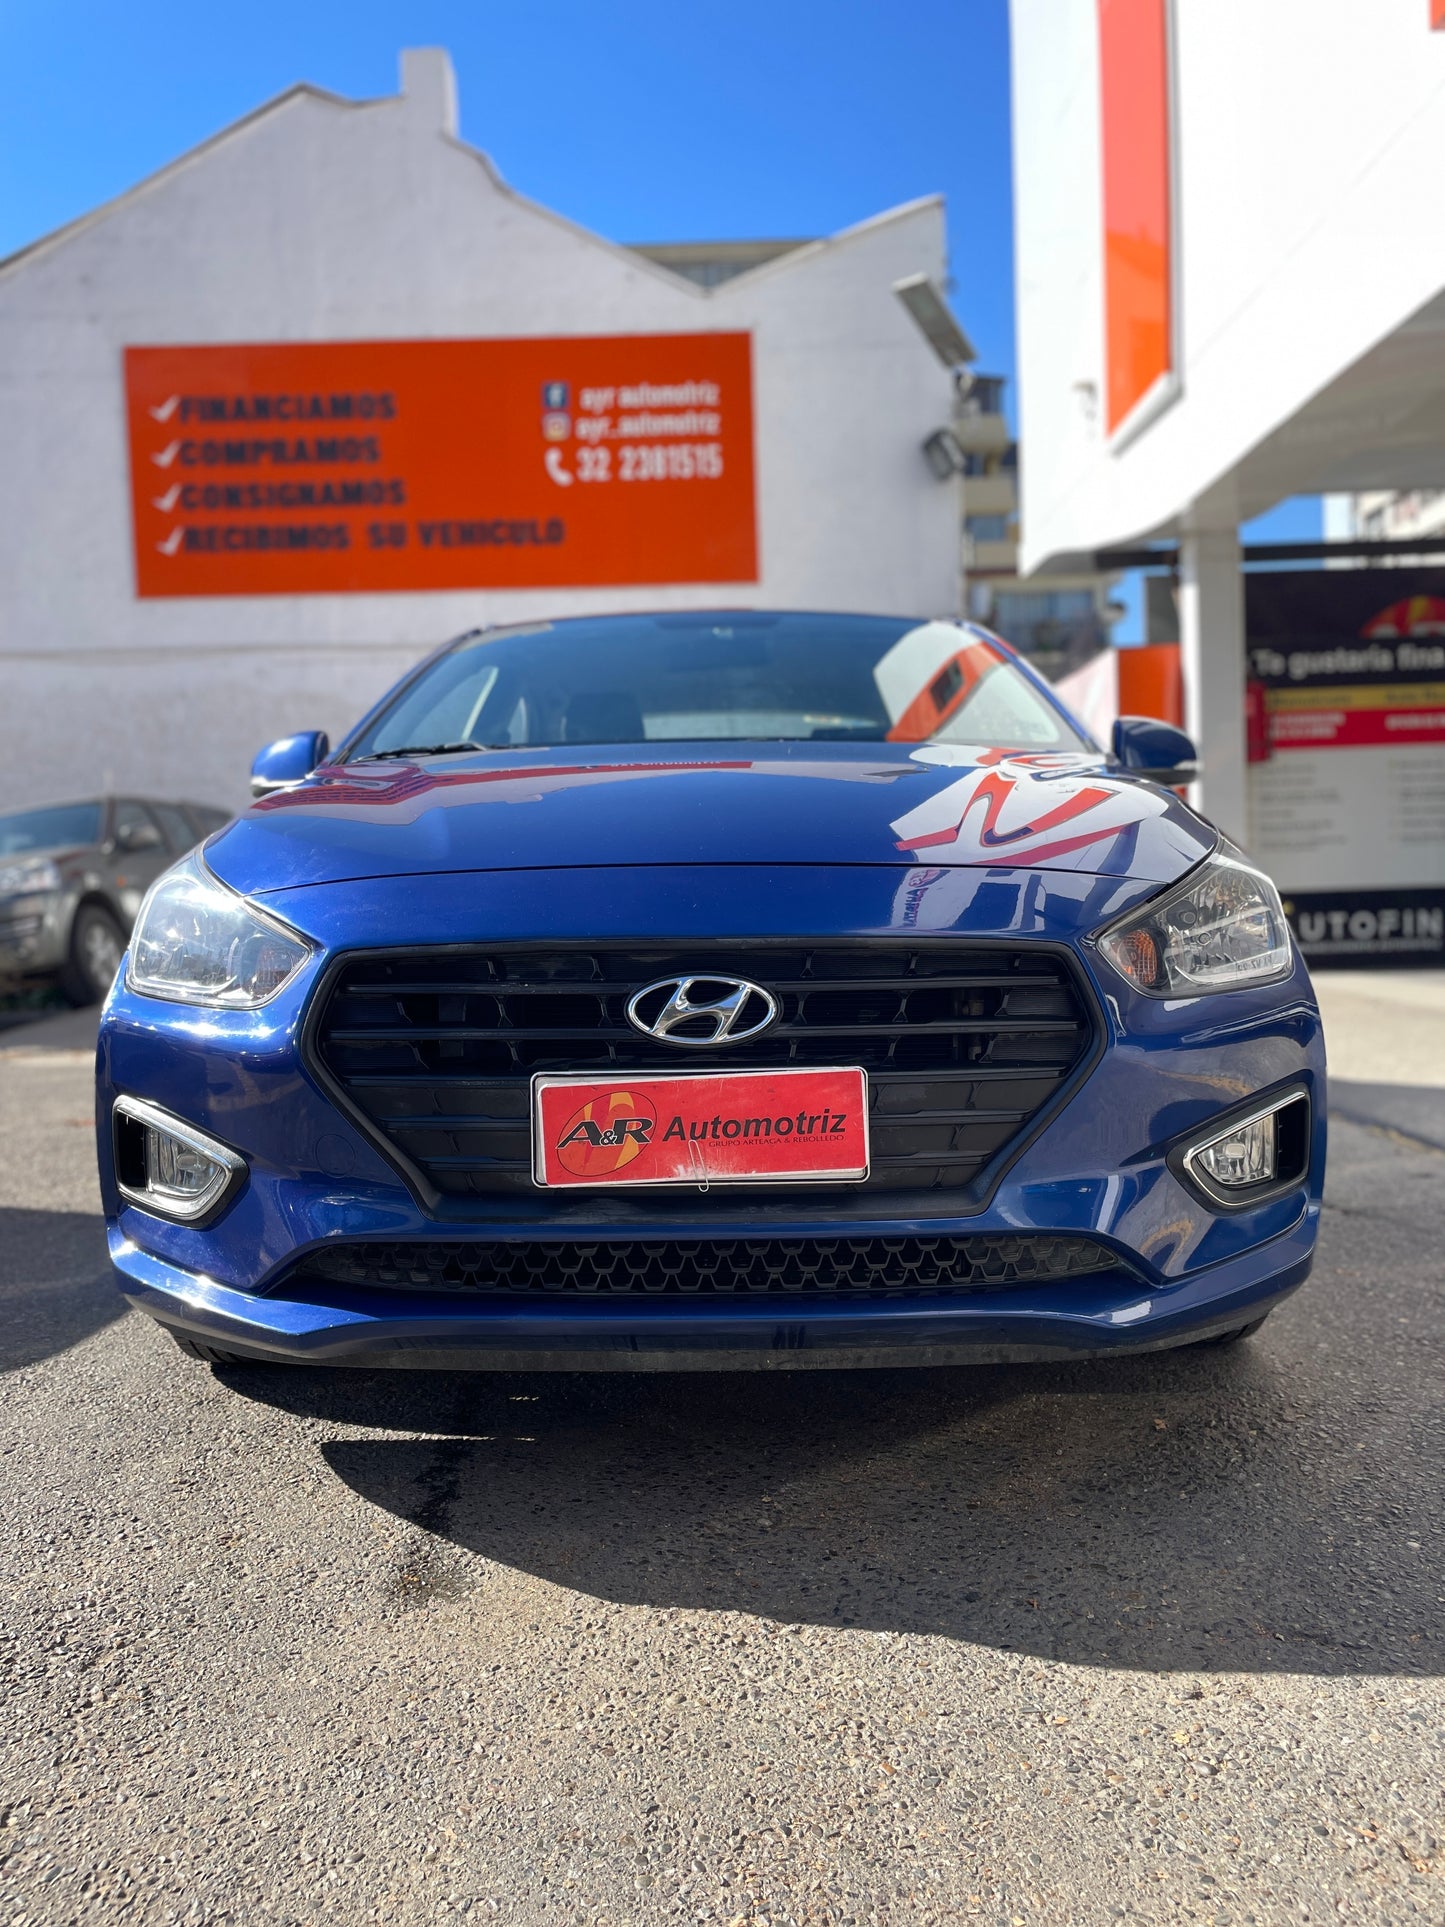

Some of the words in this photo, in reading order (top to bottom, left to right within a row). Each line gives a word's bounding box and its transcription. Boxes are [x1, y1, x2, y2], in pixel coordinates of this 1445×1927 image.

[180, 394, 396, 423] FINANCIAMOS
[618, 380, 720, 408] automotriz
[180, 436, 381, 466] COMPRAMOS
[576, 446, 611, 482] 32
[181, 479, 406, 510] CONSIGNAMOS
[184, 524, 350, 553] RECIBIMOS
[368, 521, 407, 549] SU
[418, 517, 566, 548] VEHICULO
[555, 1117, 654, 1150] A&R
[662, 1108, 847, 1142] Automotriz
[708, 1139, 740, 1148] GRUPO
[742, 1137, 782, 1146] ARTEAGA
[793, 1134, 845, 1144] REBOLLEDO
